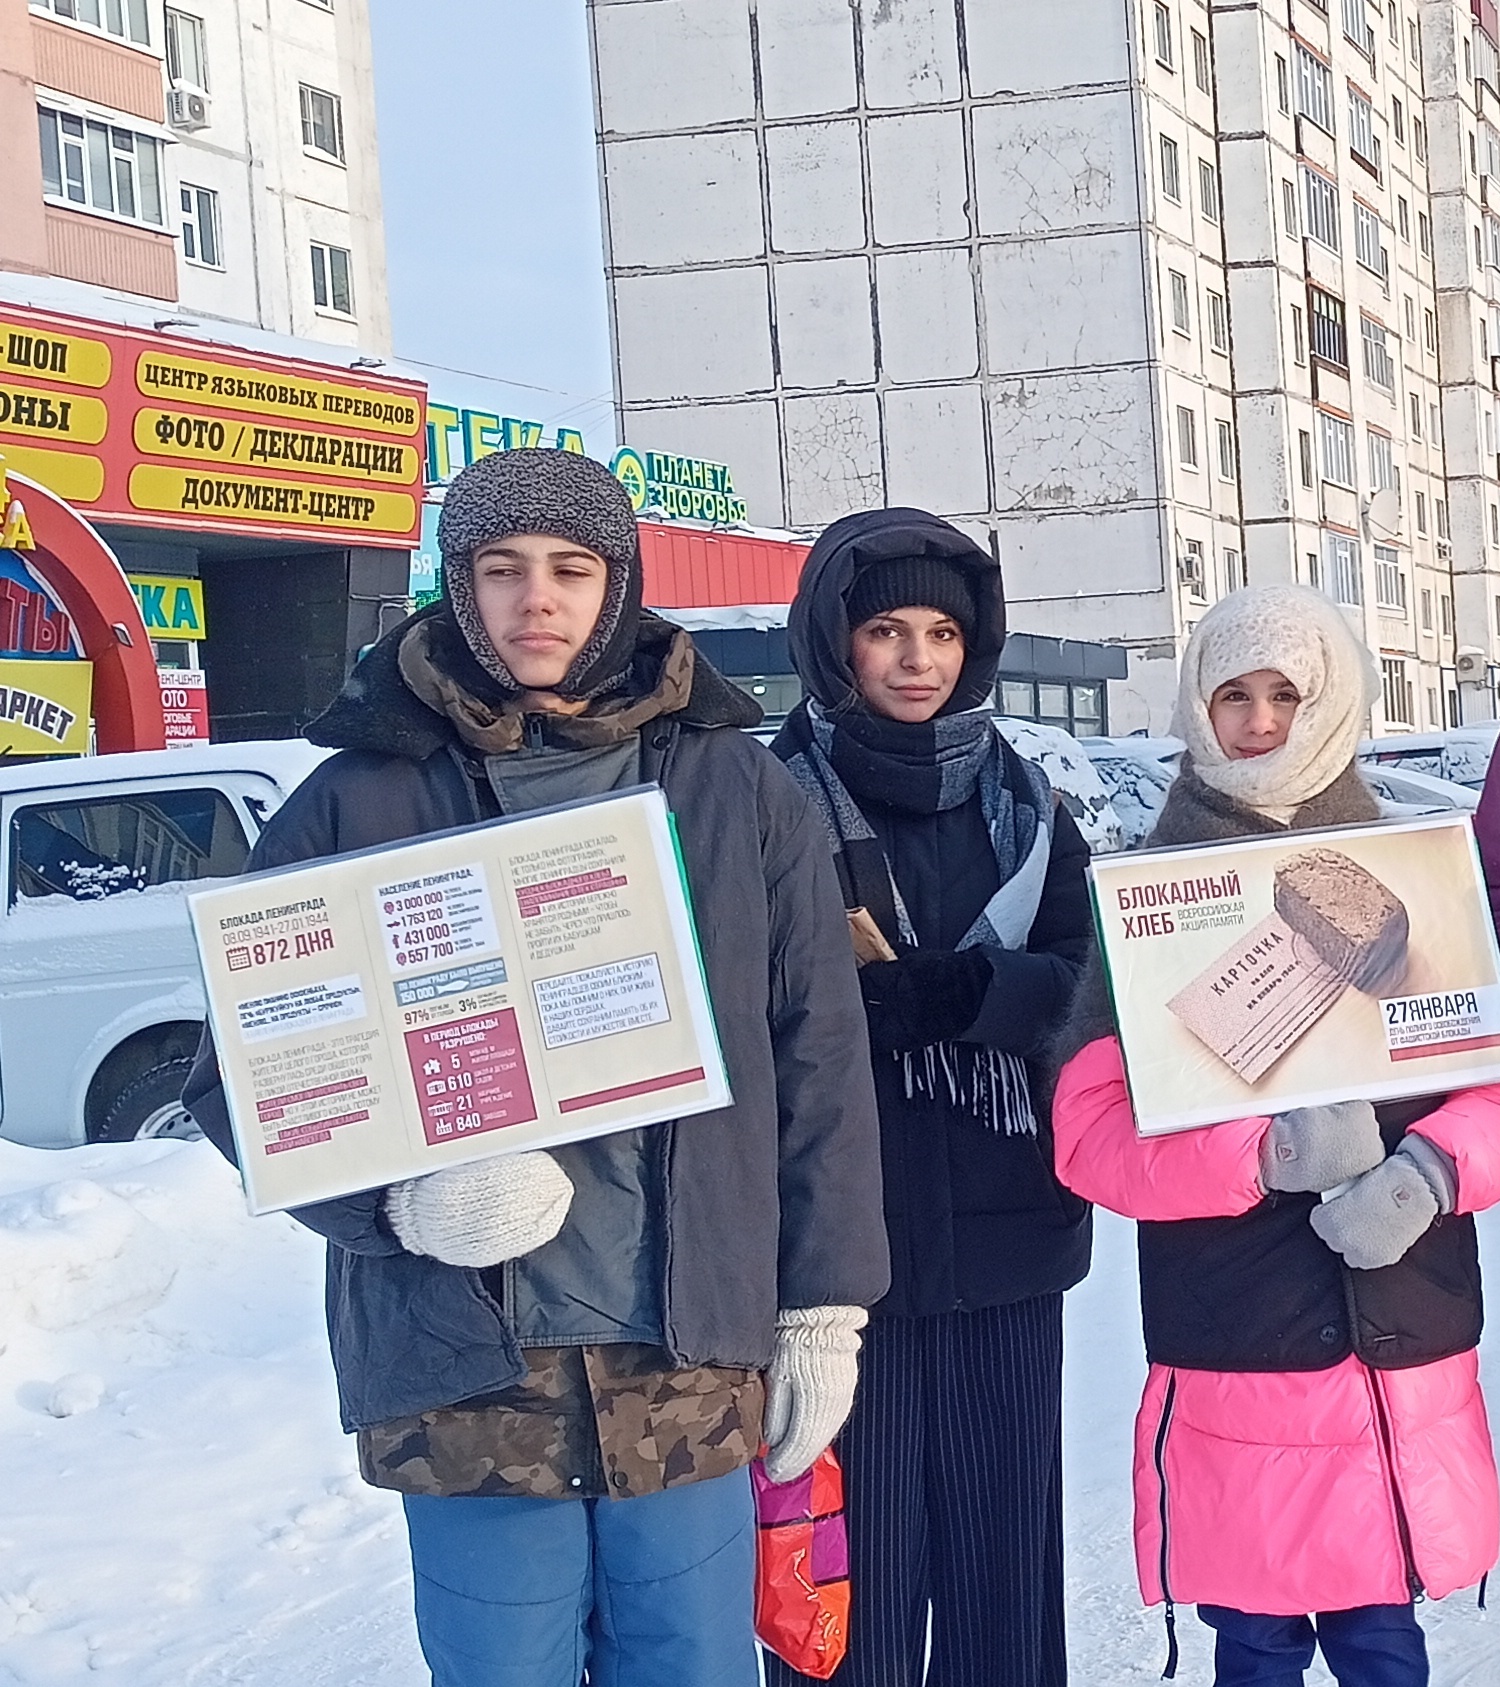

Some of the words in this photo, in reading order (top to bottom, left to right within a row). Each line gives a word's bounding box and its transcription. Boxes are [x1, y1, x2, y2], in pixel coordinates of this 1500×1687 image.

[145, 364, 208, 391] ЦЕНТР
[211, 377, 318, 409] ЯЗЫКОВЫХ
[323, 400, 415, 426] ПЕРЕВОДОВ
[155, 414, 225, 451] ФОТО
[250, 428, 403, 475] ДЕКЛАРАЦИИ
[652, 452, 735, 493] ПЛАНЕТА
[182, 478, 375, 521] ДОКУМЕНТ-ЦЕНТР
[655, 485, 748, 521] ЗДОРОВЬЯ
[131, 584, 199, 629] КА
[395, 899, 403, 912] 3
[404, 895, 423, 909] 000
[424, 891, 443, 905] 000
[1117, 870, 1241, 912] БЛОКАДНЫЙ
[220, 911, 264, 930] БЛОКАДА
[266, 897, 326, 919] ЛЕНИНГРАДА
[427, 908, 443, 921] 120
[1178, 901, 1244, 919] ВСЕРОССИЙСКАЯ
[403, 929, 425, 946] 431
[426, 923, 450, 941] 000
[1123, 912, 1174, 938] ХЛЕБ
[1180, 919, 1208, 932] АКЦИЯ
[1209, 914, 1244, 927] ПАМЯТИ
[253, 938, 290, 965] 872
[292, 928, 335, 958] ДНЯ
[408, 947, 430, 963] 557
[431, 942, 454, 958] 700
[1211, 932, 1283, 995] КАРТОЧКА
[459, 997, 477, 1012] 3%
[404, 1009, 429, 1025] 97%
[450, 1053, 461, 1070] 5
[447, 1072, 473, 1091] 610
[456, 1094, 473, 1111] 21
[456, 1112, 482, 1131] 840
